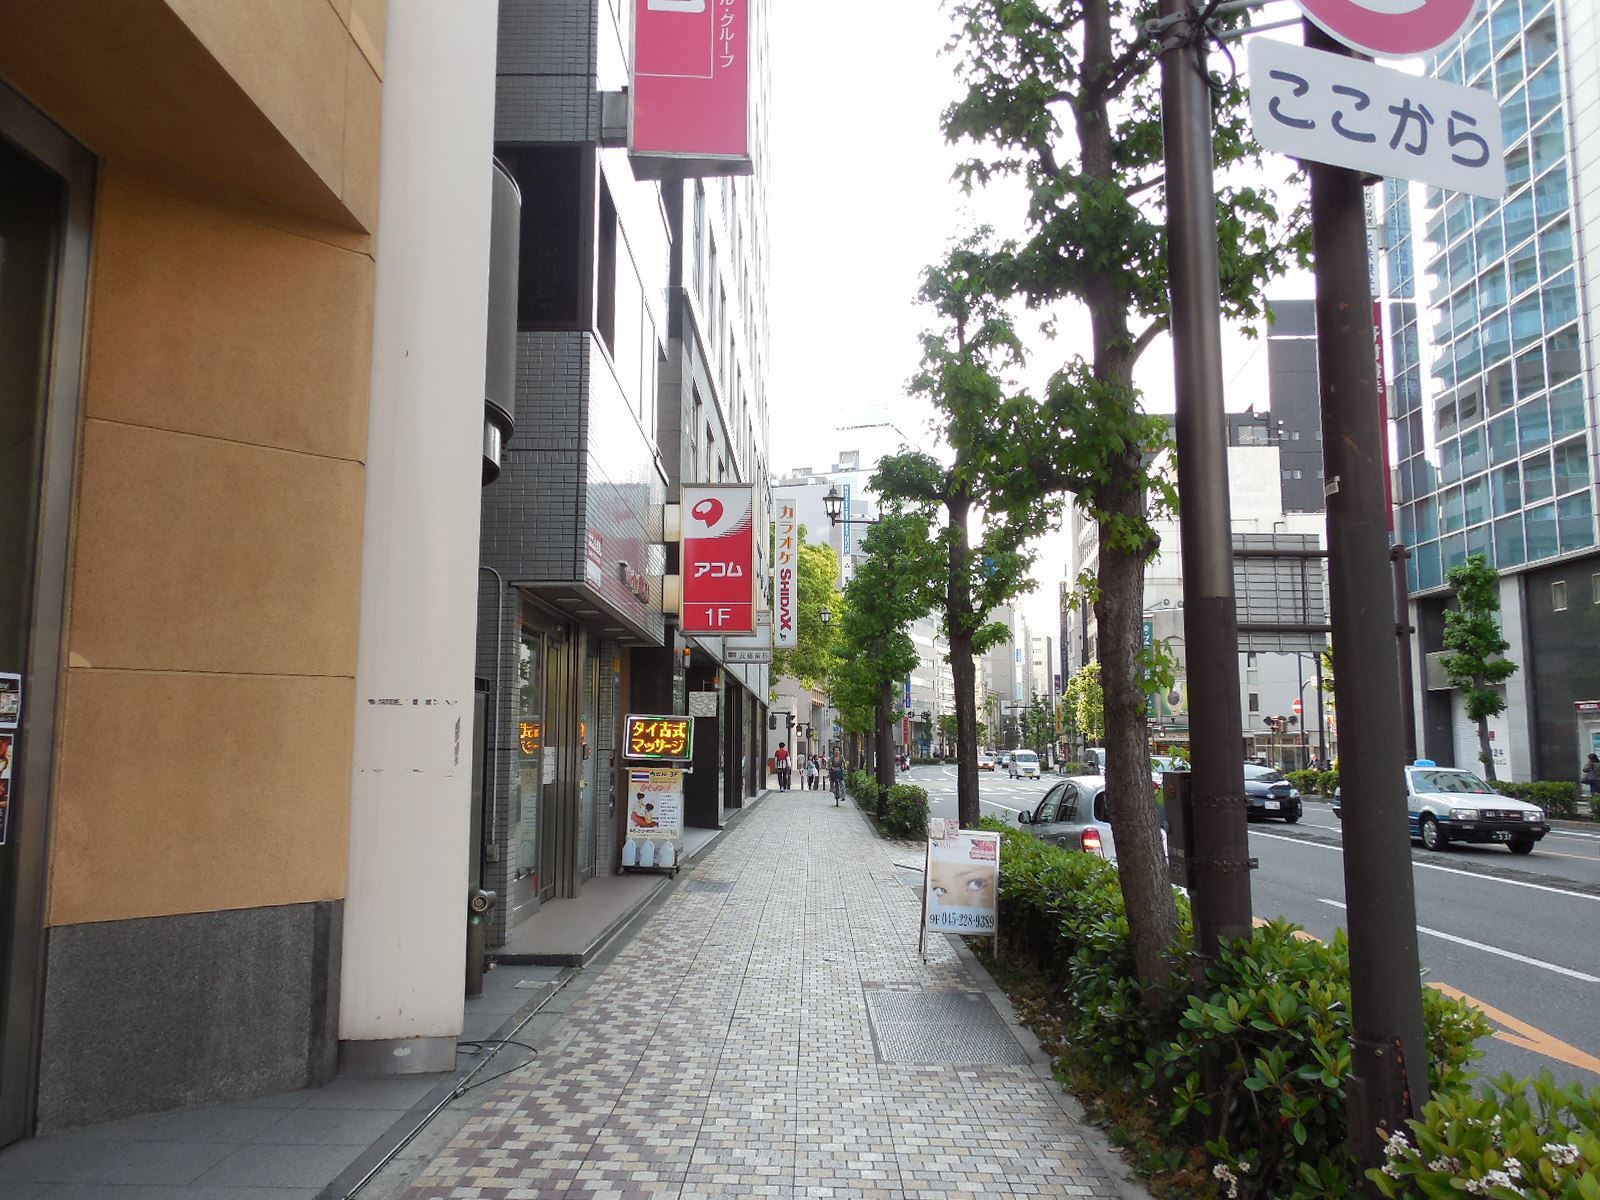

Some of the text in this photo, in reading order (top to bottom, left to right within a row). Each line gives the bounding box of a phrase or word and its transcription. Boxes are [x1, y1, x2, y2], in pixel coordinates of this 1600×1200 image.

[1269, 69, 1490, 168] ここから
[779, 505, 794, 566] カラオケ
[693, 562, 743, 578] アコム
[780, 568, 792, 631] SHIDAX
[705, 608, 732, 627] 1F
[632, 721, 687, 739] タイ古式
[631, 738, 684, 754] マッサージ
